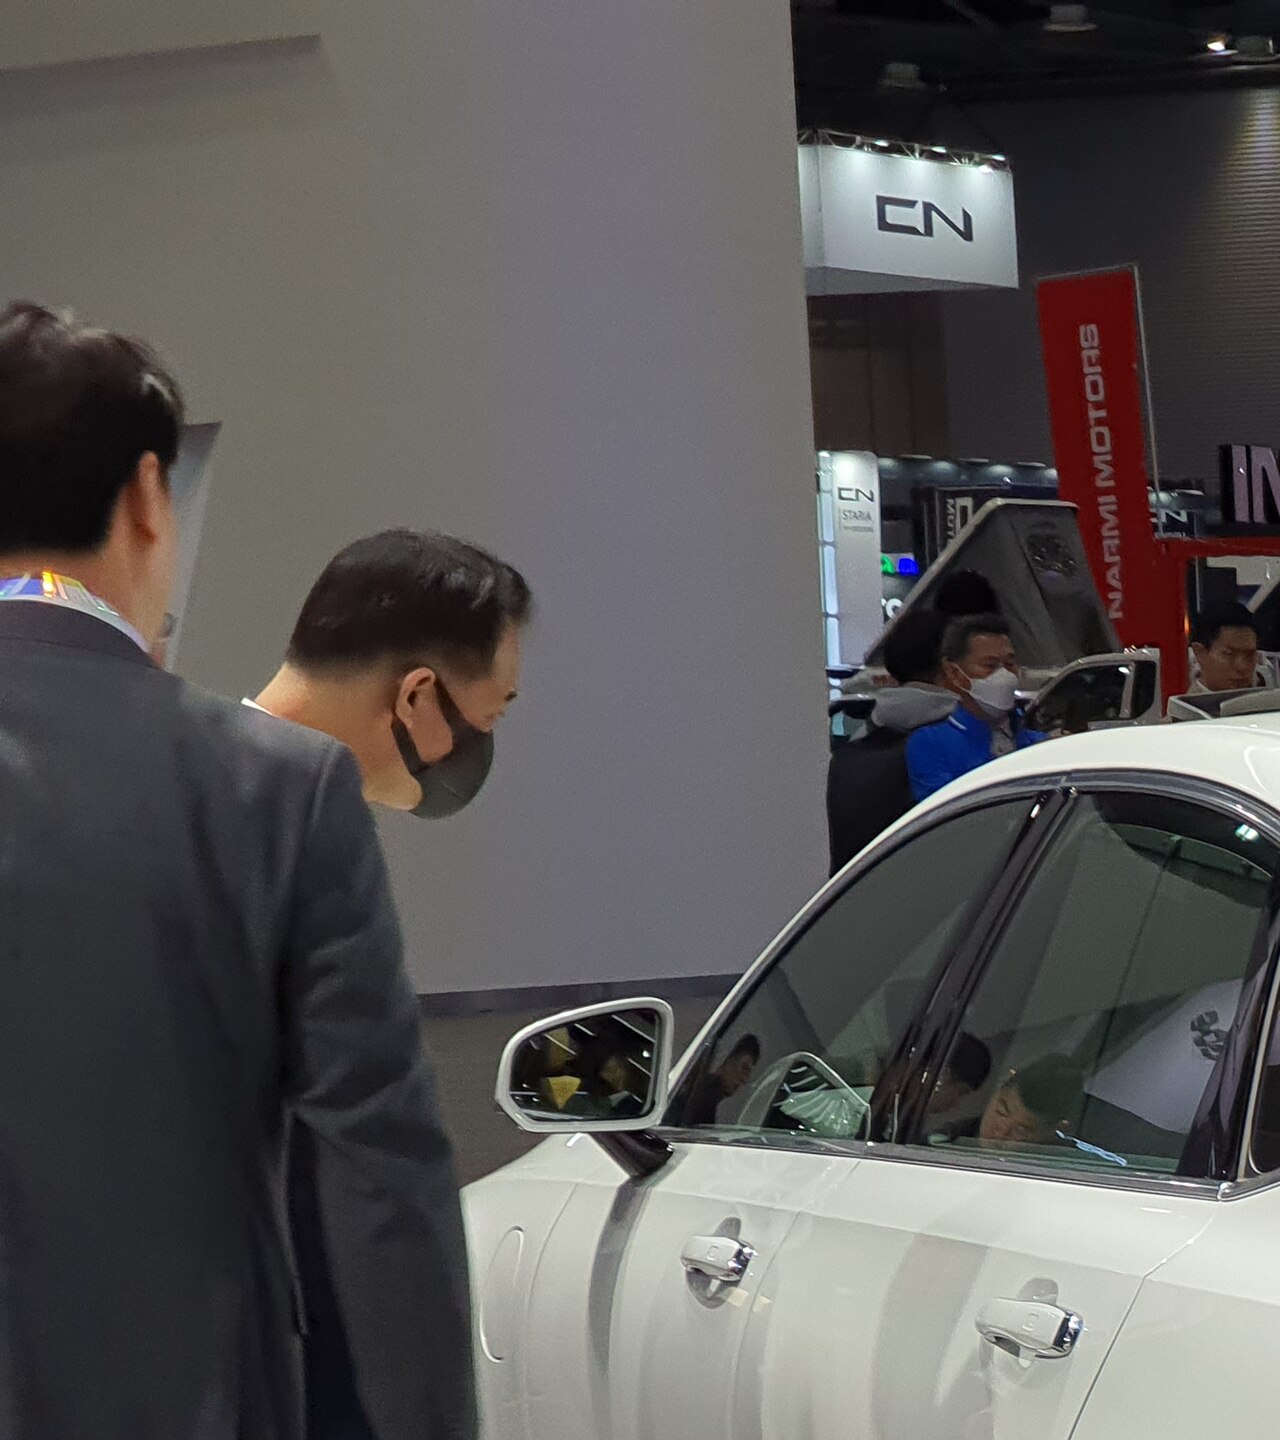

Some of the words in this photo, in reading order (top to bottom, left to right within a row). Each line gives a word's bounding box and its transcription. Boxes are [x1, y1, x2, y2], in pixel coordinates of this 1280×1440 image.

[876, 195, 973, 242] CN
[1078, 322, 1117, 489] MOTORS
[837, 486, 875, 503] CN
[1097, 494, 1124, 620] NARMI
